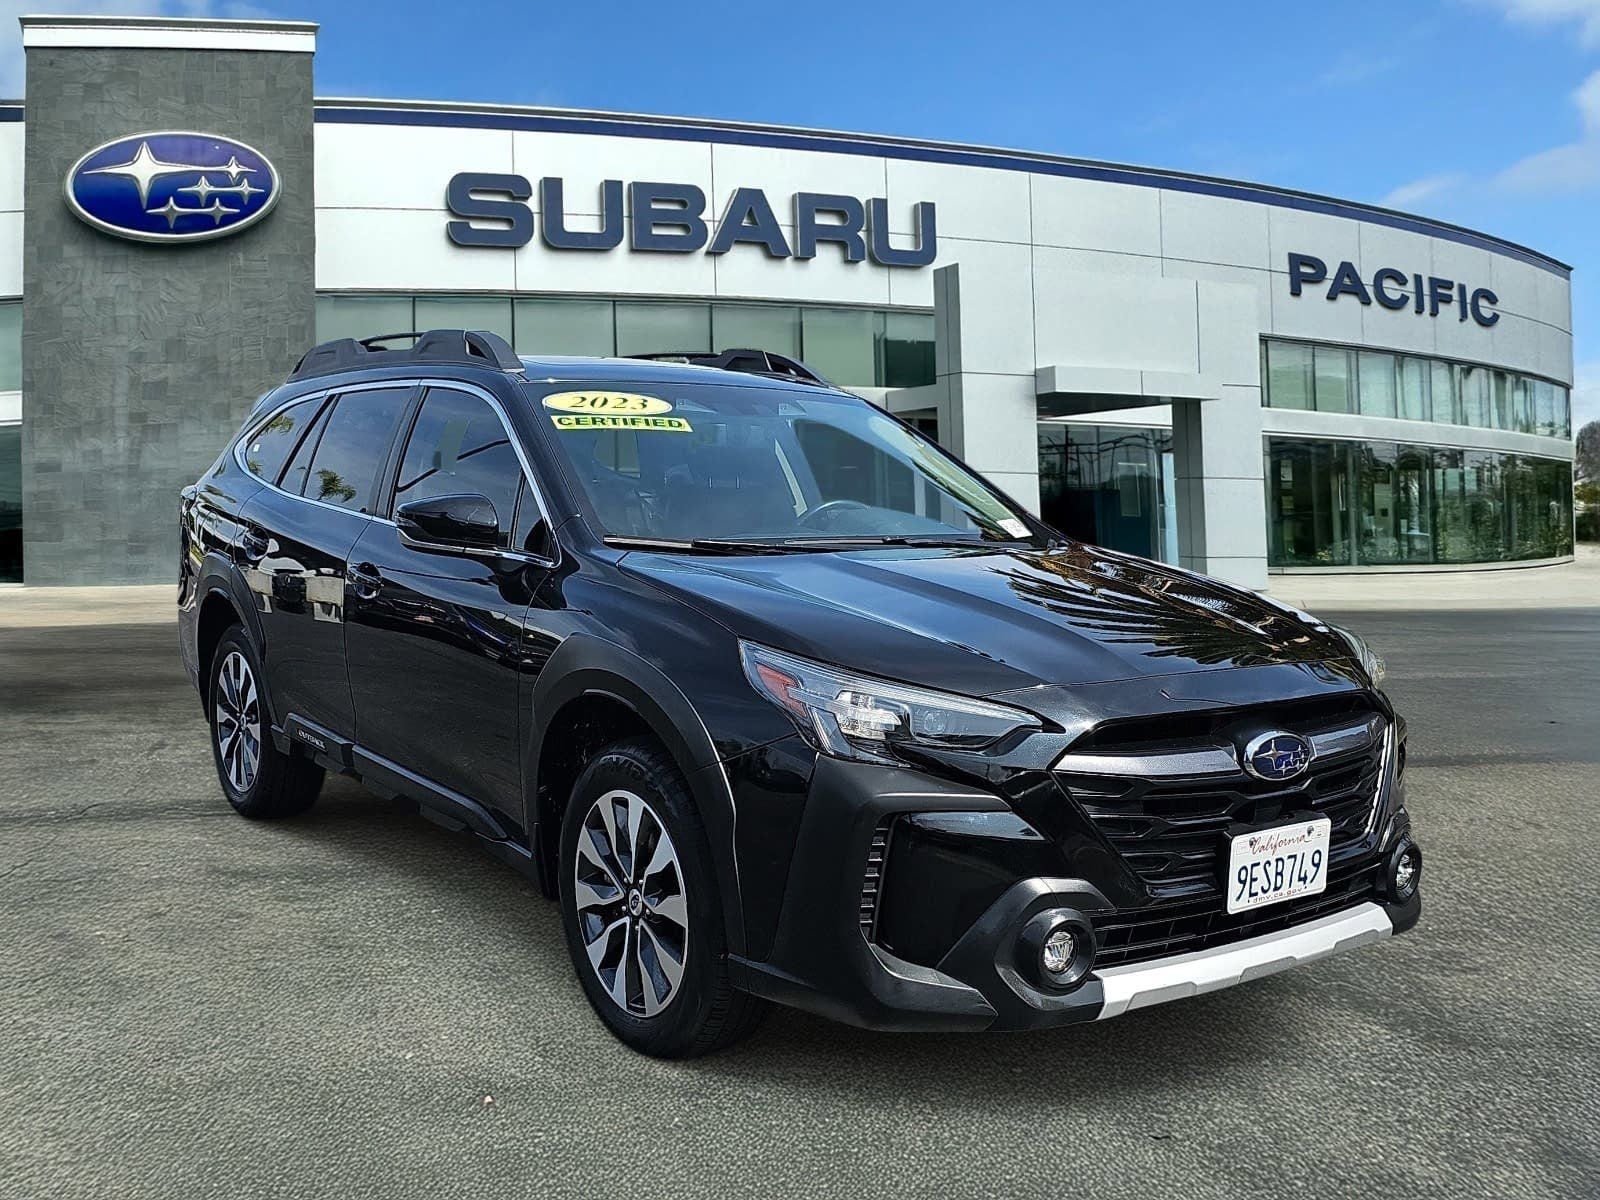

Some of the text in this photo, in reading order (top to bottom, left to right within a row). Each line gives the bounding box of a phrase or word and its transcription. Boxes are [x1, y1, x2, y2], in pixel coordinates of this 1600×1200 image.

[447, 172, 937, 267] SUBARU
[1288, 252, 1500, 327] PACIFIC
[569, 396, 649, 410] 2023
[557, 416, 684, 428] CERTIFIED
[1250, 833, 1312, 856] California
[1235, 849, 1322, 902] 9ESB749
[1252, 887, 1303, 904] dmv.ca.gov
